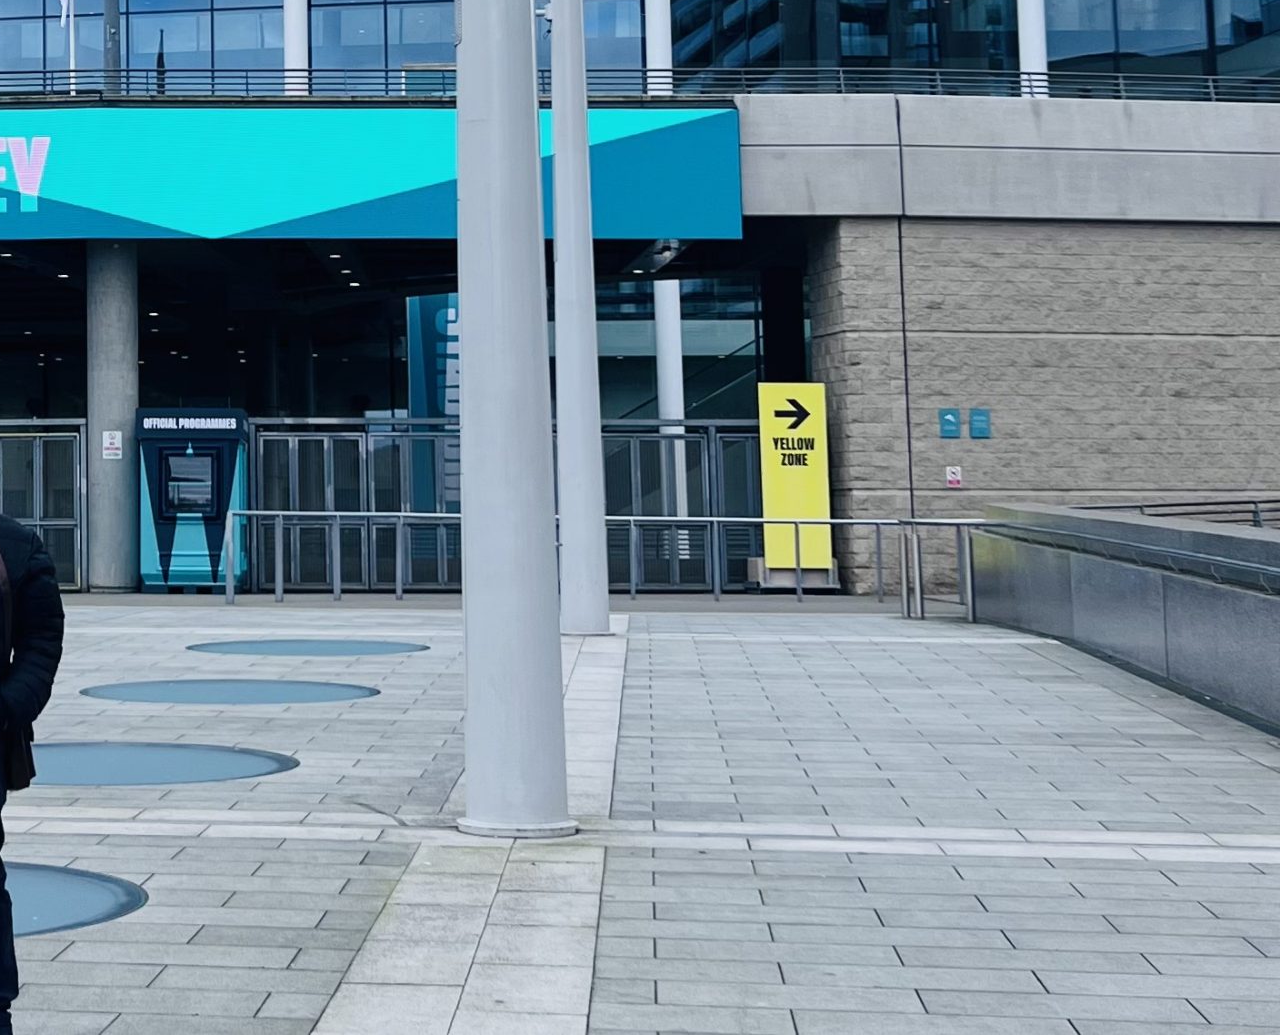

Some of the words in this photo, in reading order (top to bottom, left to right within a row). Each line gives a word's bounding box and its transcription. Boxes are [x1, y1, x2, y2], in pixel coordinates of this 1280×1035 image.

[143, 417, 178, 430] OFFICIAL
[179, 417, 237, 430] PROGRAMMES
[772, 438, 815, 451] YELLOW
[780, 453, 809, 466] ZONE
